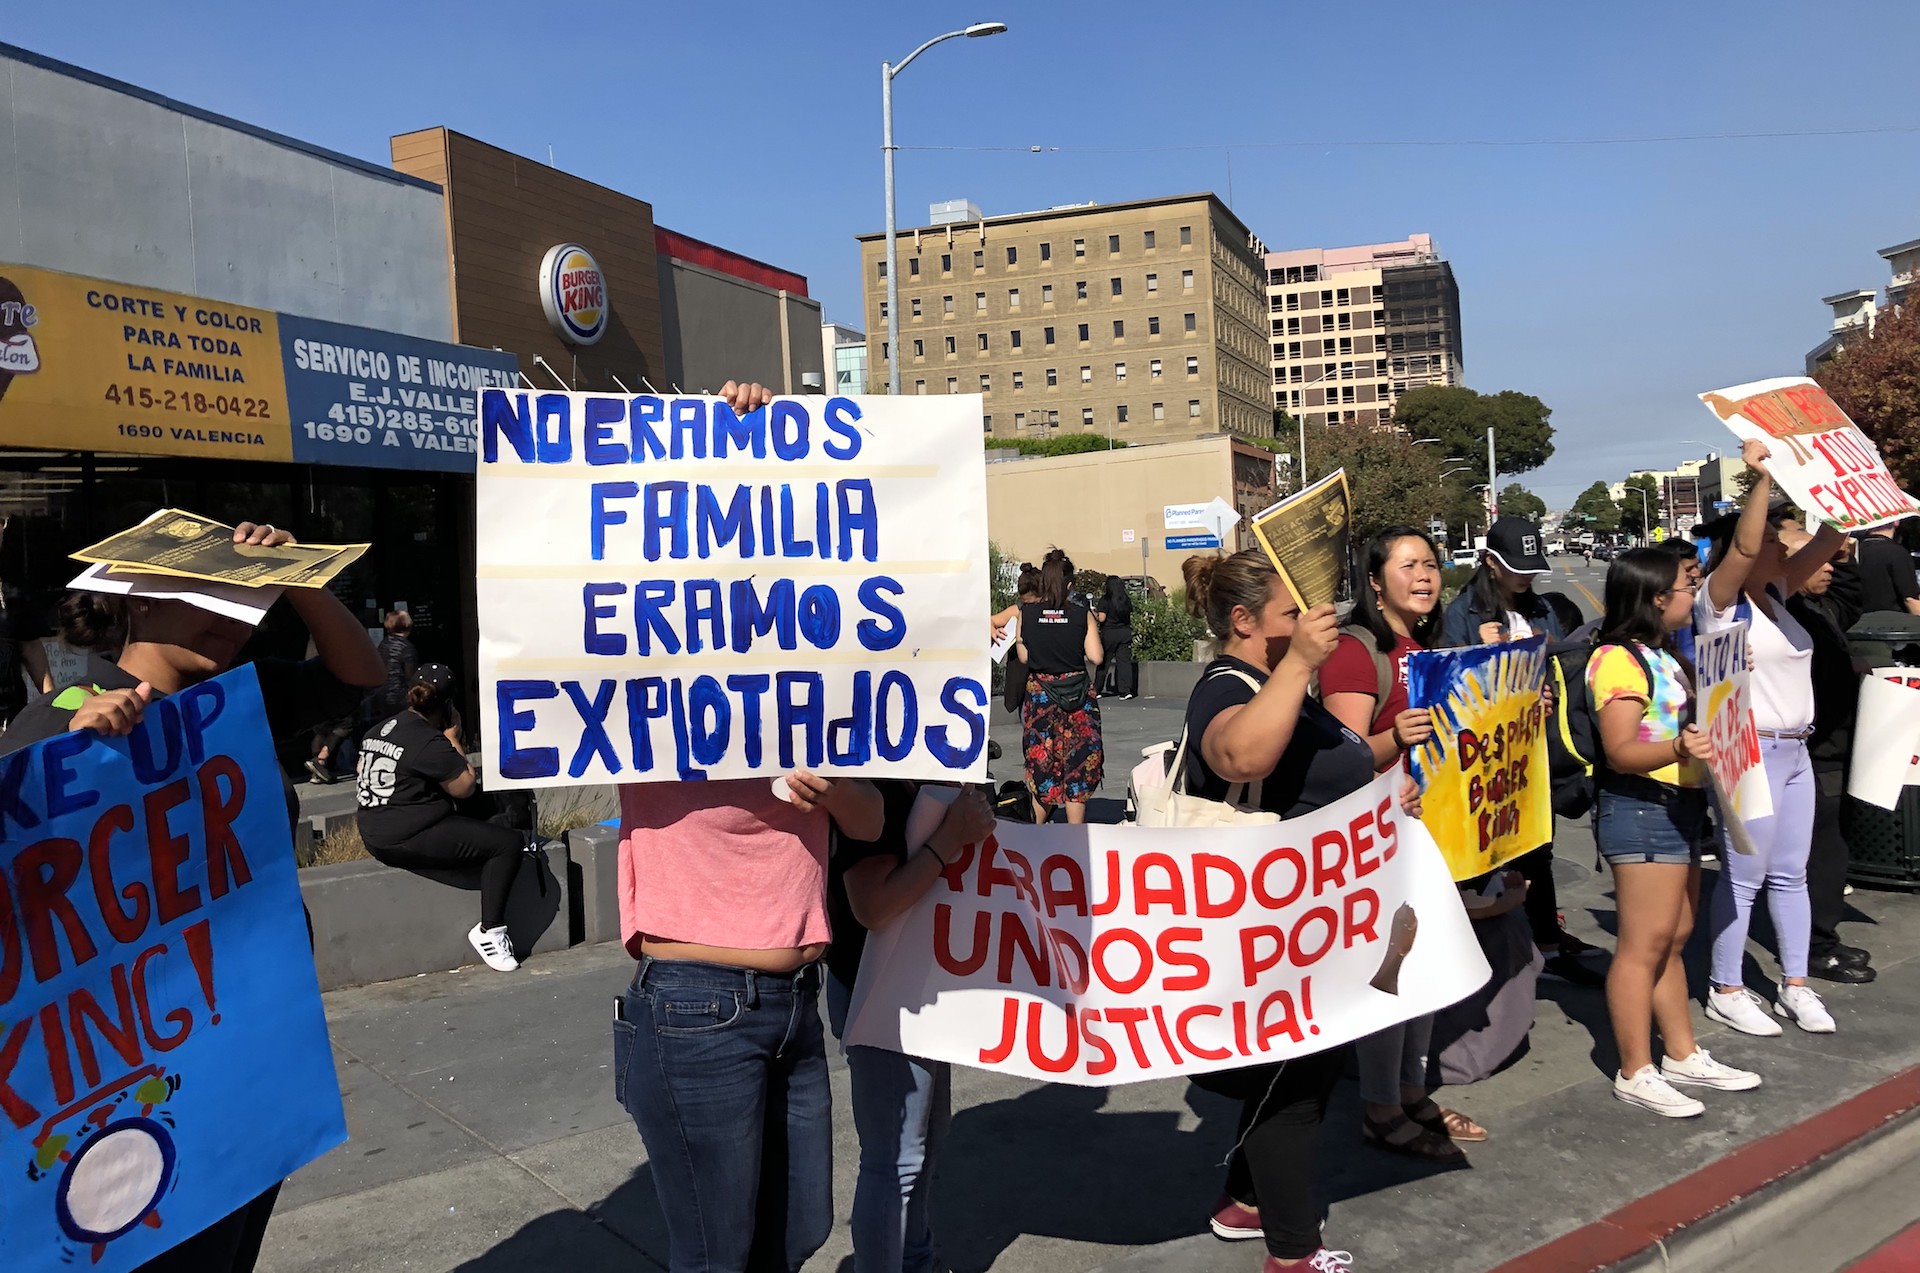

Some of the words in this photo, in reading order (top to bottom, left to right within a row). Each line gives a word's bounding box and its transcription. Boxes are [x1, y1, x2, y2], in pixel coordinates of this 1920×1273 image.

[562, 270, 600, 290] BURGER
[564, 285, 603, 313] KING
[86, 290, 165, 319] CORTE
[174, 305, 187, 322] Y
[195, 309, 262, 334] COLOR
[123, 325, 181, 349] PARA
[188, 335, 242, 357] TODA
[127, 353, 156, 373] LA
[163, 358, 245, 383] FAMILIA
[293, 338, 391, 380] SERVICIO
[397, 354, 422, 384] DE
[105, 384, 271, 419] 415-218-0422
[118, 424, 163, 438] 1690
[170, 427, 265, 445] VALENCIA
[304, 421, 372, 445] 1690
[382, 430, 400, 447] A
[481, 389, 573, 464] NO
[584, 393, 864, 466] ERAMOS
[590, 477, 879, 562] FAMILIA
[1267, 524, 1288, 540] TAKE
[1290, 508, 1319, 529] ACTION
[1273, 532, 1295, 548] WITH
[583, 574, 907, 657] ERAMOS
[1699, 633, 1730, 688] ALTO
[1732, 629, 1746, 674] AL
[129, 680, 226, 784] UP
[1240, 887, 1380, 987] POR
[978, 979, 1321, 1076] JUSTICIA!
